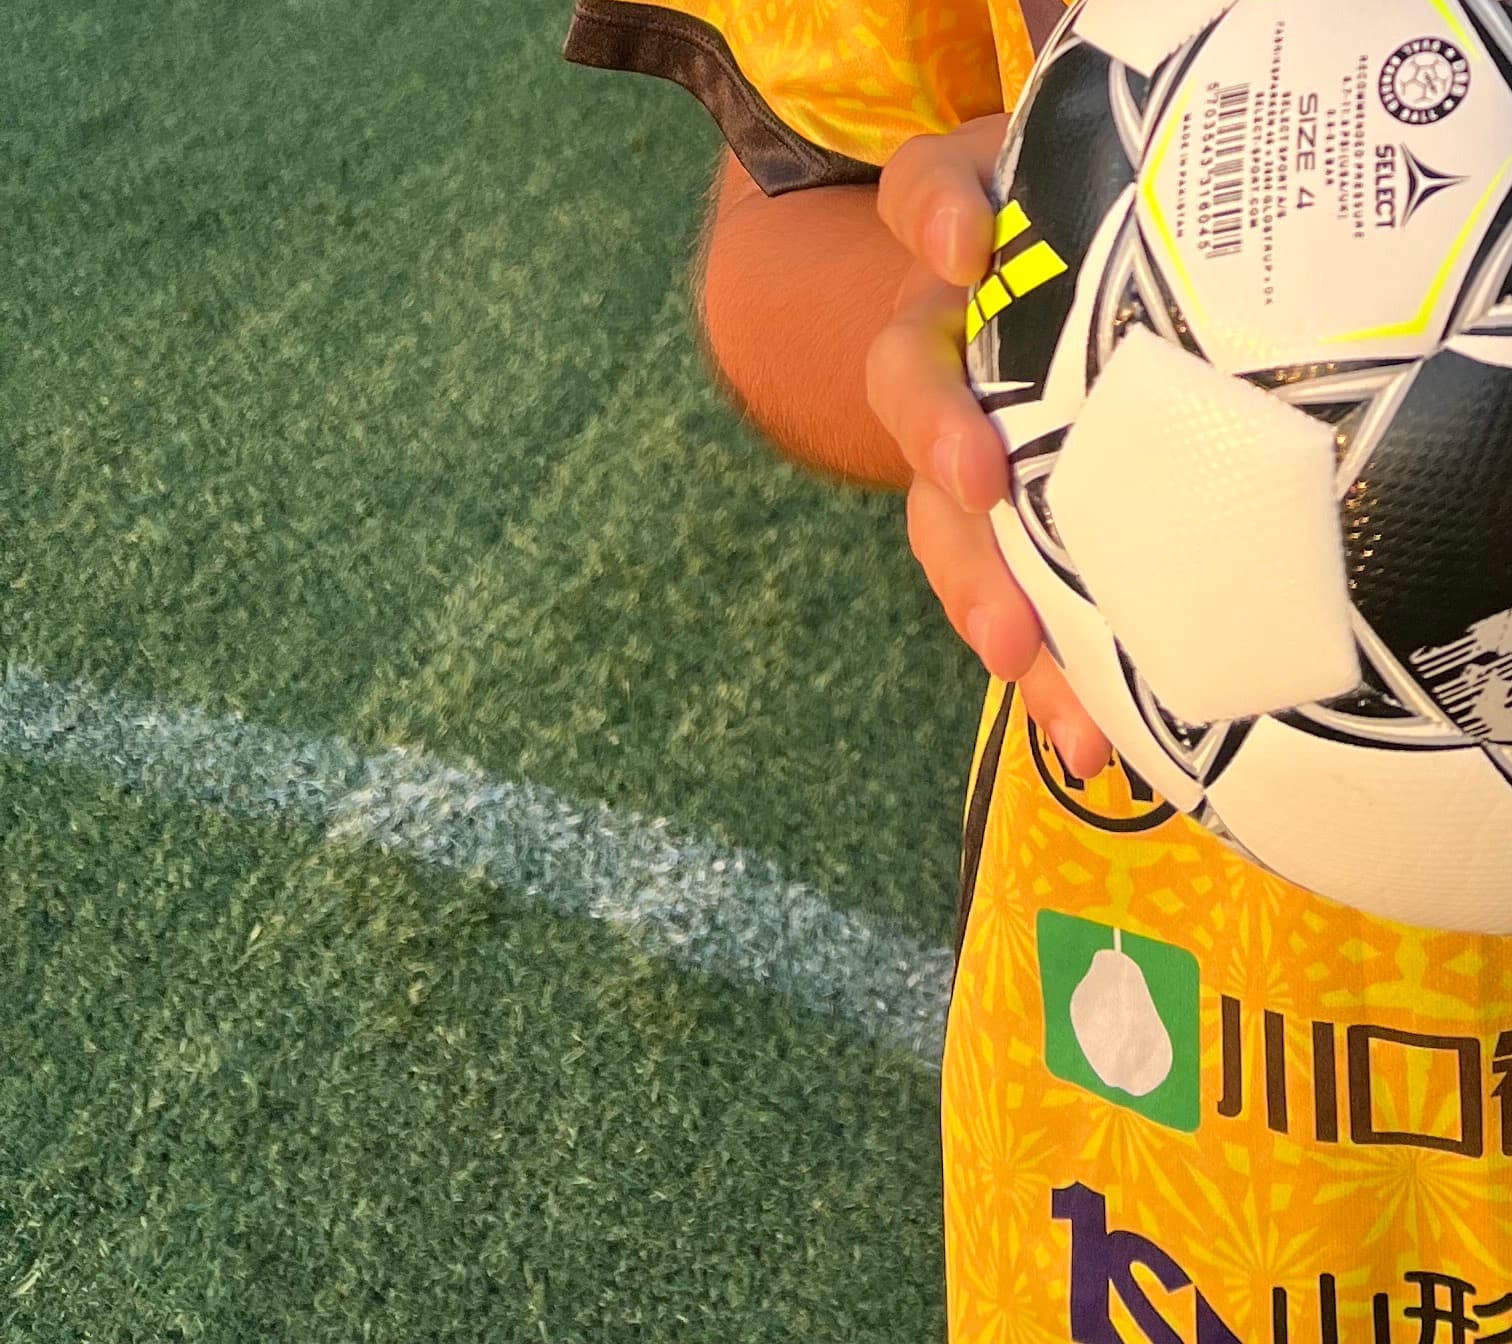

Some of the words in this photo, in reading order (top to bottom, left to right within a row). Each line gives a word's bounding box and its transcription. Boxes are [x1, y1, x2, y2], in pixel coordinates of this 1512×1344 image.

[1179, 112, 1192, 148] MADE
[1277, 91, 1291, 142] SELECT
[1296, 92, 1318, 173] SIZE
[1353, 55, 1367, 160] RECOMMENDED
[1178, 153, 1189, 167] IN
[1276, 146, 1287, 192] SPORT
[1374, 143, 1396, 230] SELECT
[1175, 170, 1188, 239] PAKISTAN
[1296, 185, 1315, 210] 4
[1352, 162, 1364, 239] PRESSURE
